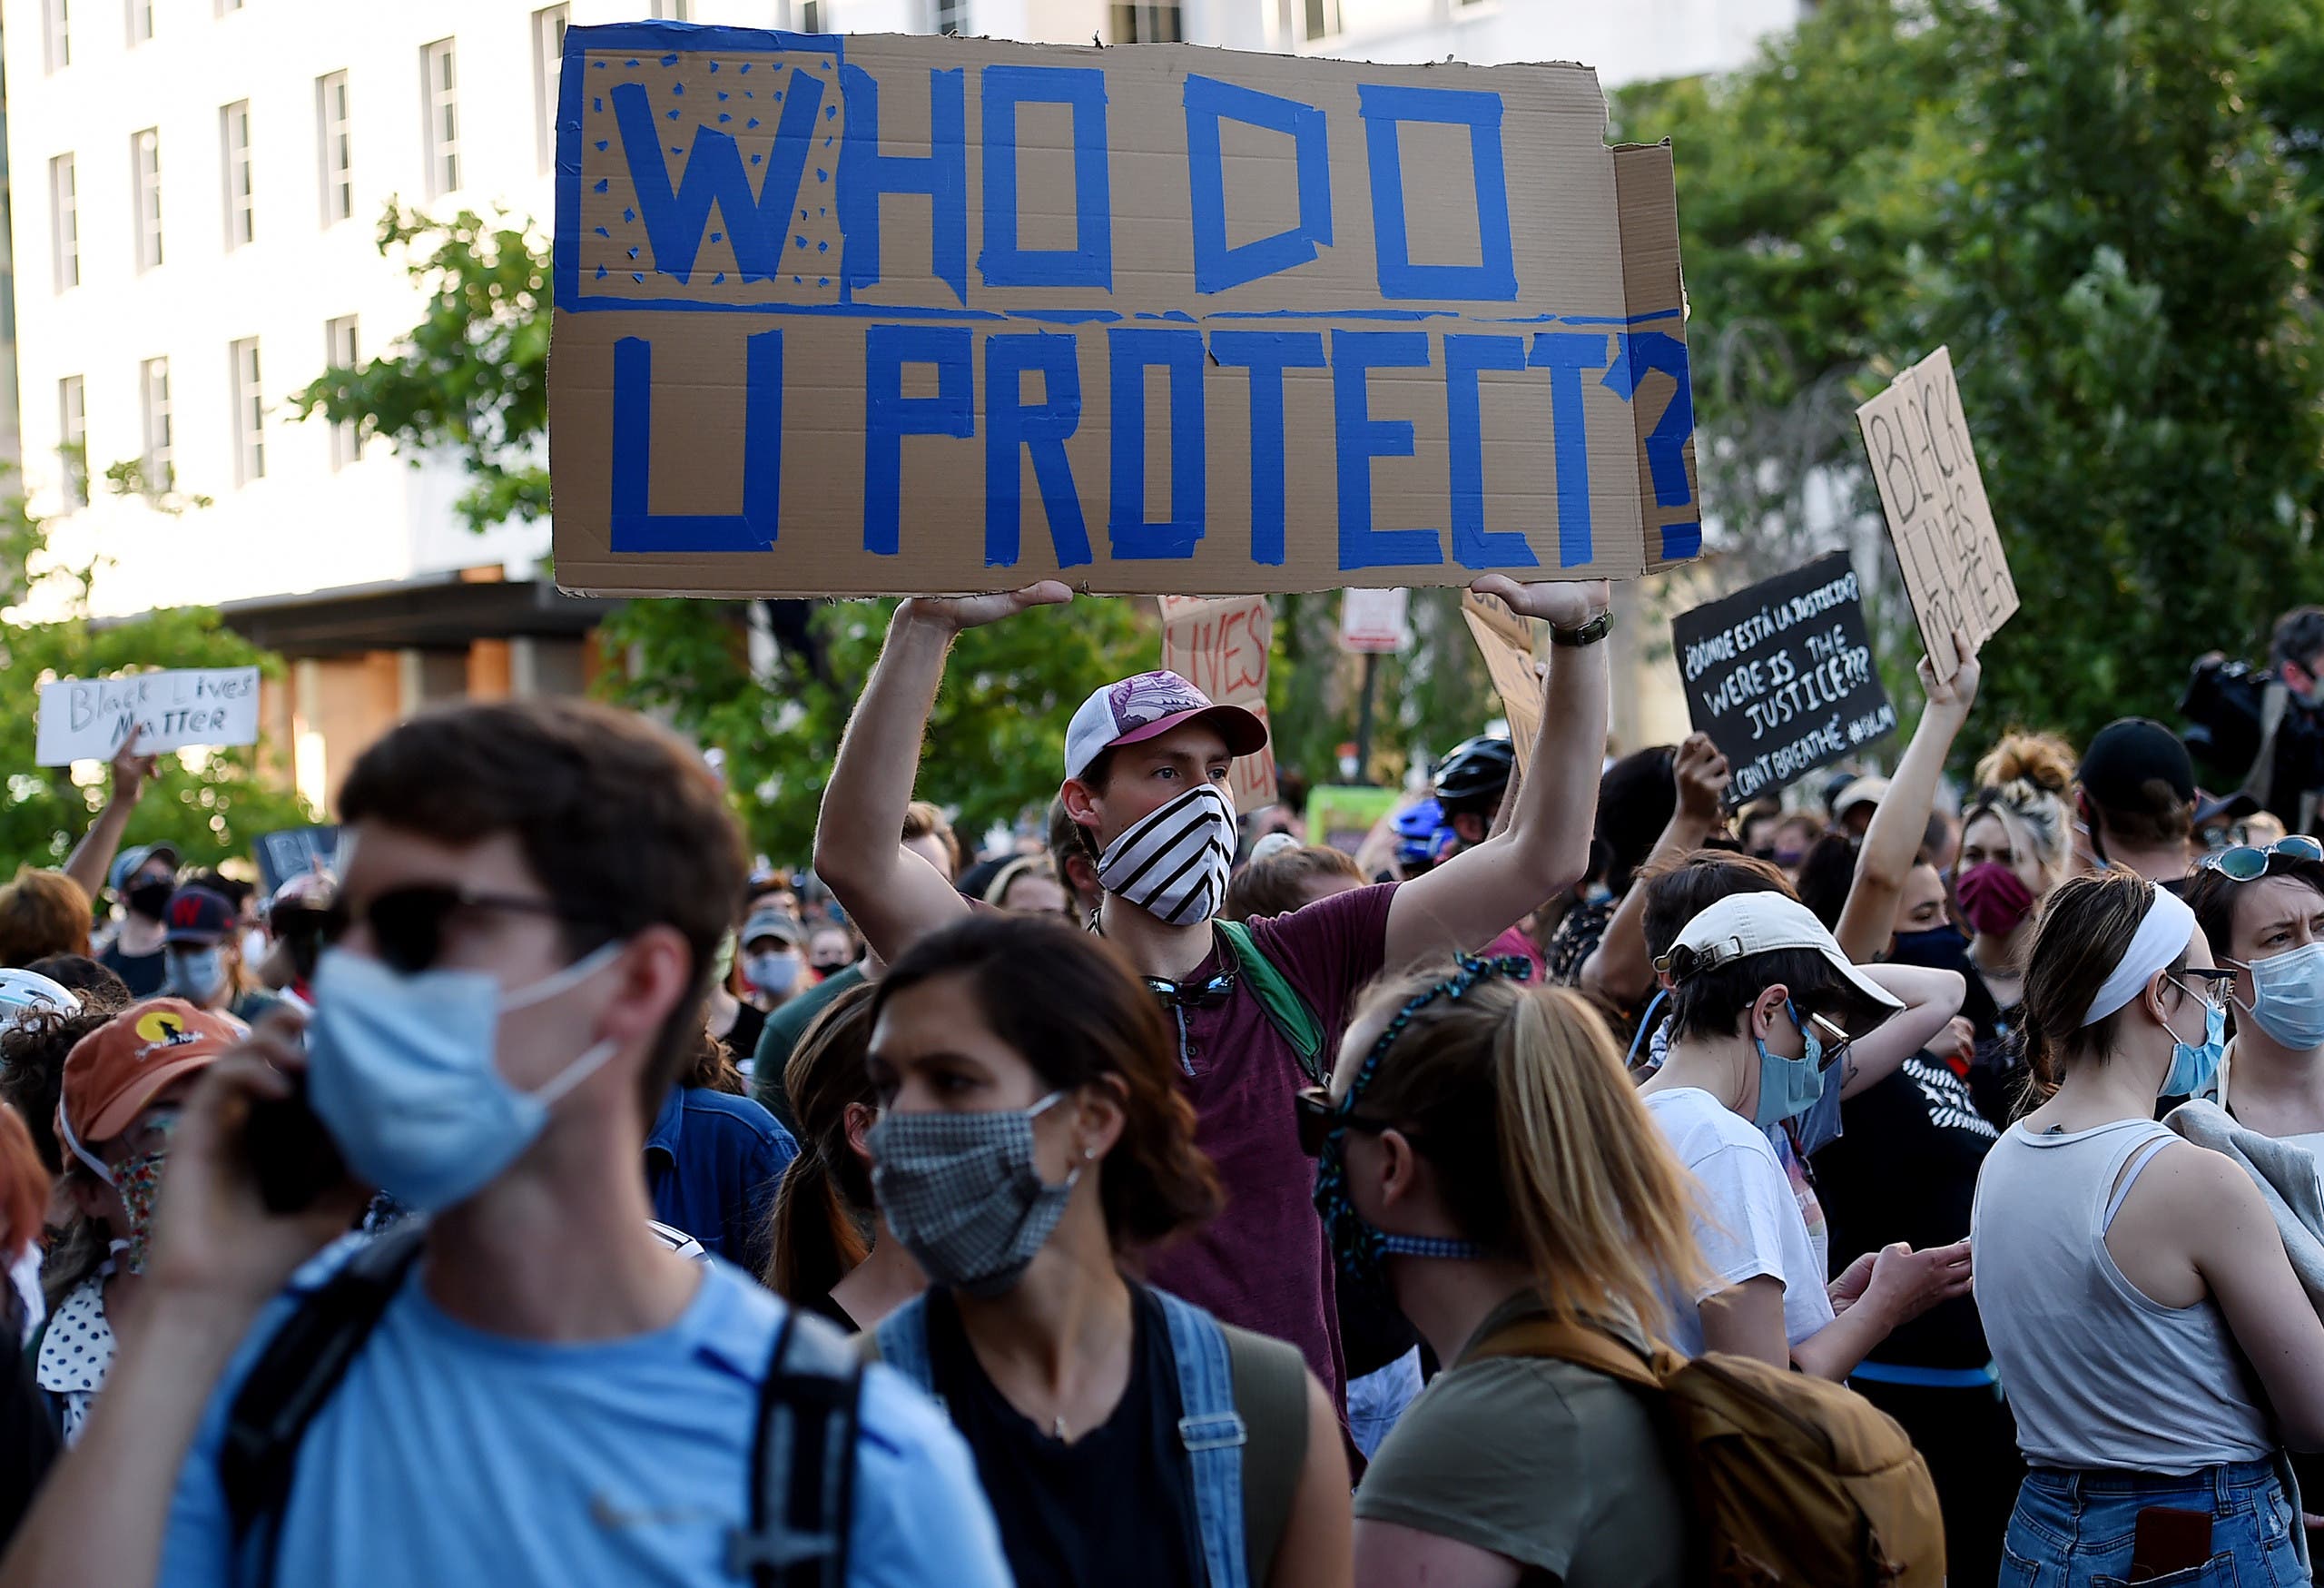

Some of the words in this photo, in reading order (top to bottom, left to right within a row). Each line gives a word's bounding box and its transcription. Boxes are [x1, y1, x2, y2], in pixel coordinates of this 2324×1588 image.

[610, 64, 1113, 307] WHO
[1183, 74, 1517, 301] DO
[610, 329, 783, 553] U
[863, 324, 1702, 569] PROTECT?
[1870, 373, 1973, 524] BLACK
[1903, 483, 1979, 603] LIVES
[1773, 604, 1795, 631] LA
[70, 684, 150, 733] Black
[1702, 660, 1768, 718] WERE
[1767, 648, 1796, 687] IS
[1805, 624, 1848, 662] THE
[1744, 646, 1870, 740] JUSTICE???
[1736, 753, 1773, 798] CAN'T
[1846, 703, 1897, 745] #BLM
